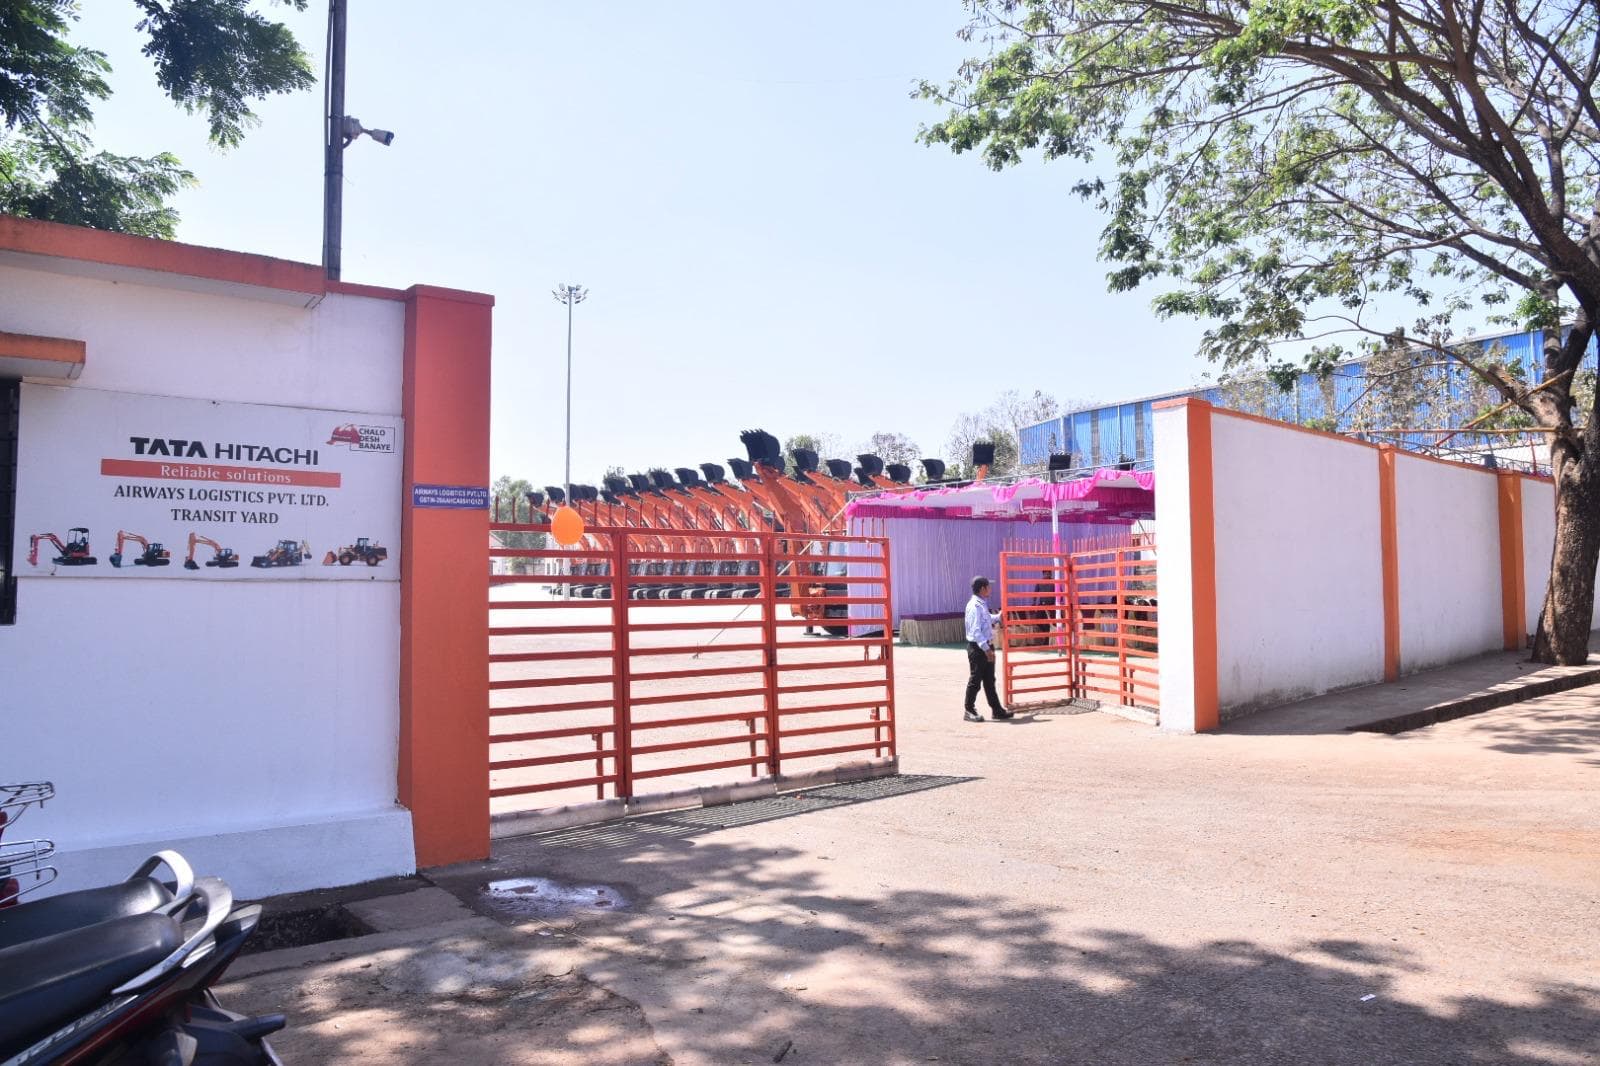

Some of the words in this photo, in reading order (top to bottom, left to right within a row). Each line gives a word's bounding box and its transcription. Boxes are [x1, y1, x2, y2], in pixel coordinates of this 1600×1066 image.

[359, 428, 386, 436] CHALO
[130, 437, 208, 459] TATA
[214, 443, 319, 465] HITACHI
[359, 443, 391, 451] BANAYE
[160, 465, 220, 481] Reliable
[226, 468, 292, 484] solutions
[114, 485, 186, 500] AIRWAYS
[188, 488, 264, 504] LOGISTICS
[267, 492, 297, 505] PVT.
[300, 494, 329, 507] LTD.
[439, 489, 466, 497] LOGISTICS
[171, 508, 237, 523] TRANSIT
[241, 511, 279, 524] YARD
